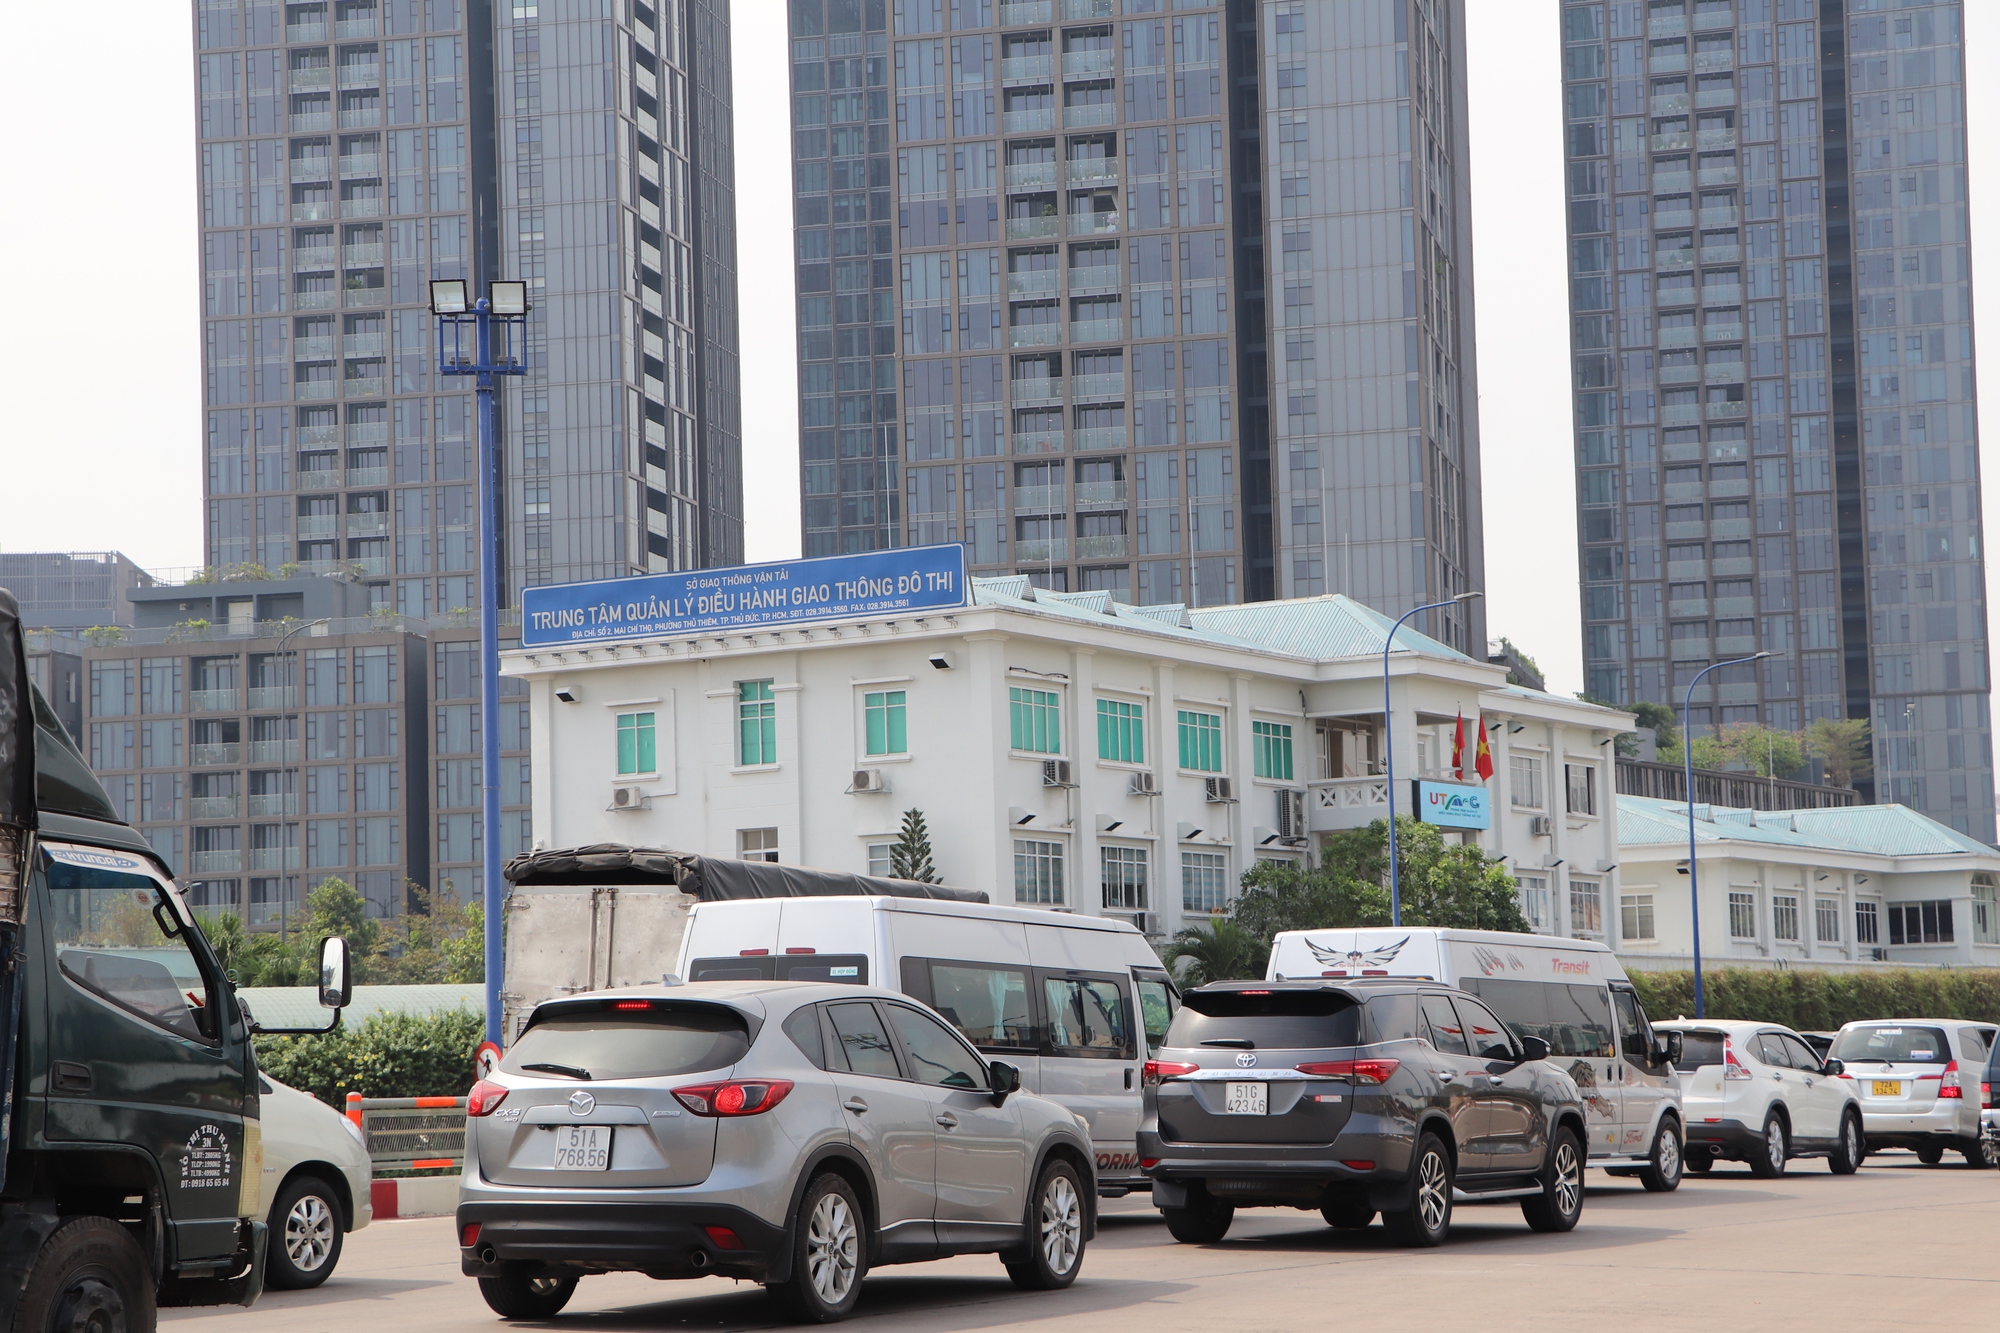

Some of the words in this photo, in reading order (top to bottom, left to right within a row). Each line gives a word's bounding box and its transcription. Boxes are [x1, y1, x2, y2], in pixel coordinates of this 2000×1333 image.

[686, 578, 698, 590] SỞ
[700, 577, 720, 588] GIAO
[722, 573, 752, 587] THÔNG
[754, 571, 773, 584] VẬN
[775, 568, 789, 580] TẢI
[531, 608, 584, 630] TRUNG
[588, 602, 622, 625] TÂM
[626, 595, 670, 621] QUẢN
[674, 592, 694, 617] LÝ
[698, 587, 735, 614] ĐIỀU
[740, 586, 787, 611] HÀNH
[791, 584, 830, 606] GIAO
[835, 576, 893, 601] THÔNG
[898, 570, 922, 595] ĐÔ
[926, 570, 953, 593] THỊ
[572, 630, 583, 640] ĐỊA
[598, 626, 607, 636] SỐ
[614, 626, 626, 635] MAI
[627, 624, 638, 633] CHÍ
[655, 619, 682, 631] PHƯỜNG
[683, 617, 696, 628] THỦ
[731, 613, 744, 624] THỦ
[850, 603, 866, 612] FAX:
[66, 852, 118, 866] HYUNDAI
[1552, 958, 1590, 975] Transit
[1235, 1084, 1258, 1099] 51G
[494, 1108, 522, 1118] CX-5
[1227, 1100, 1266, 1114] 423.46
[186, 1130, 200, 1152] THỊ
[201, 1125, 219, 1135] THU
[202, 1137, 212, 1148] 3N
[570, 1129, 597, 1148] 51A
[1623, 1129, 1645, 1144] Ford
[557, 1148, 606, 1168] 768.56
